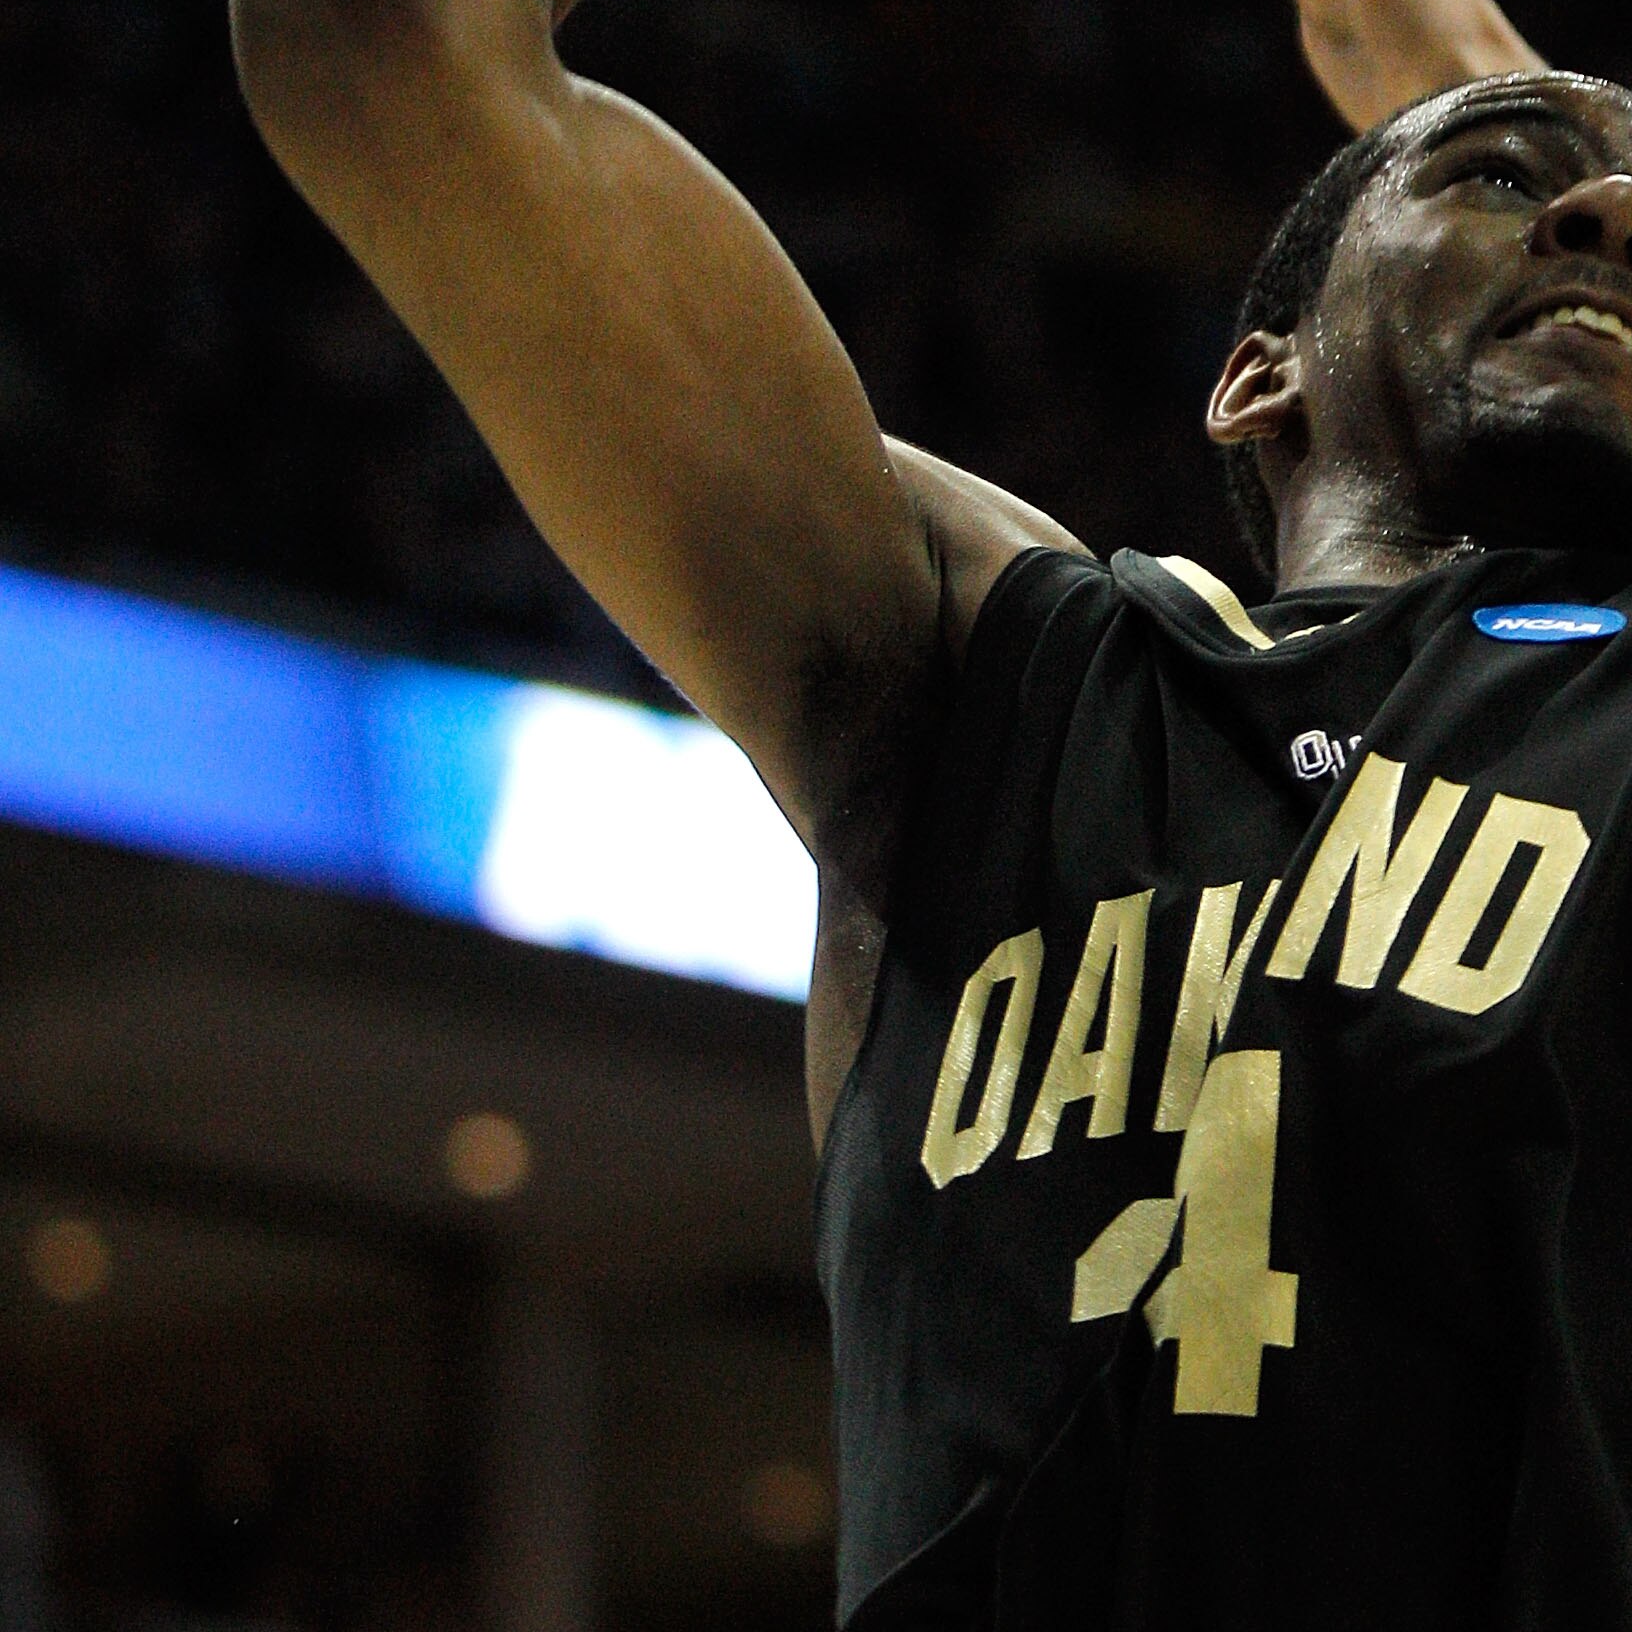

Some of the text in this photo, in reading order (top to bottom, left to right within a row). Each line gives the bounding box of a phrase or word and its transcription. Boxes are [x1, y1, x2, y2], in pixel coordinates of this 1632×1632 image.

[1491, 617, 1602, 635] NCAA
[919, 751, 1593, 1191] OAKND
[1069, 1048, 1300, 1419] 4
